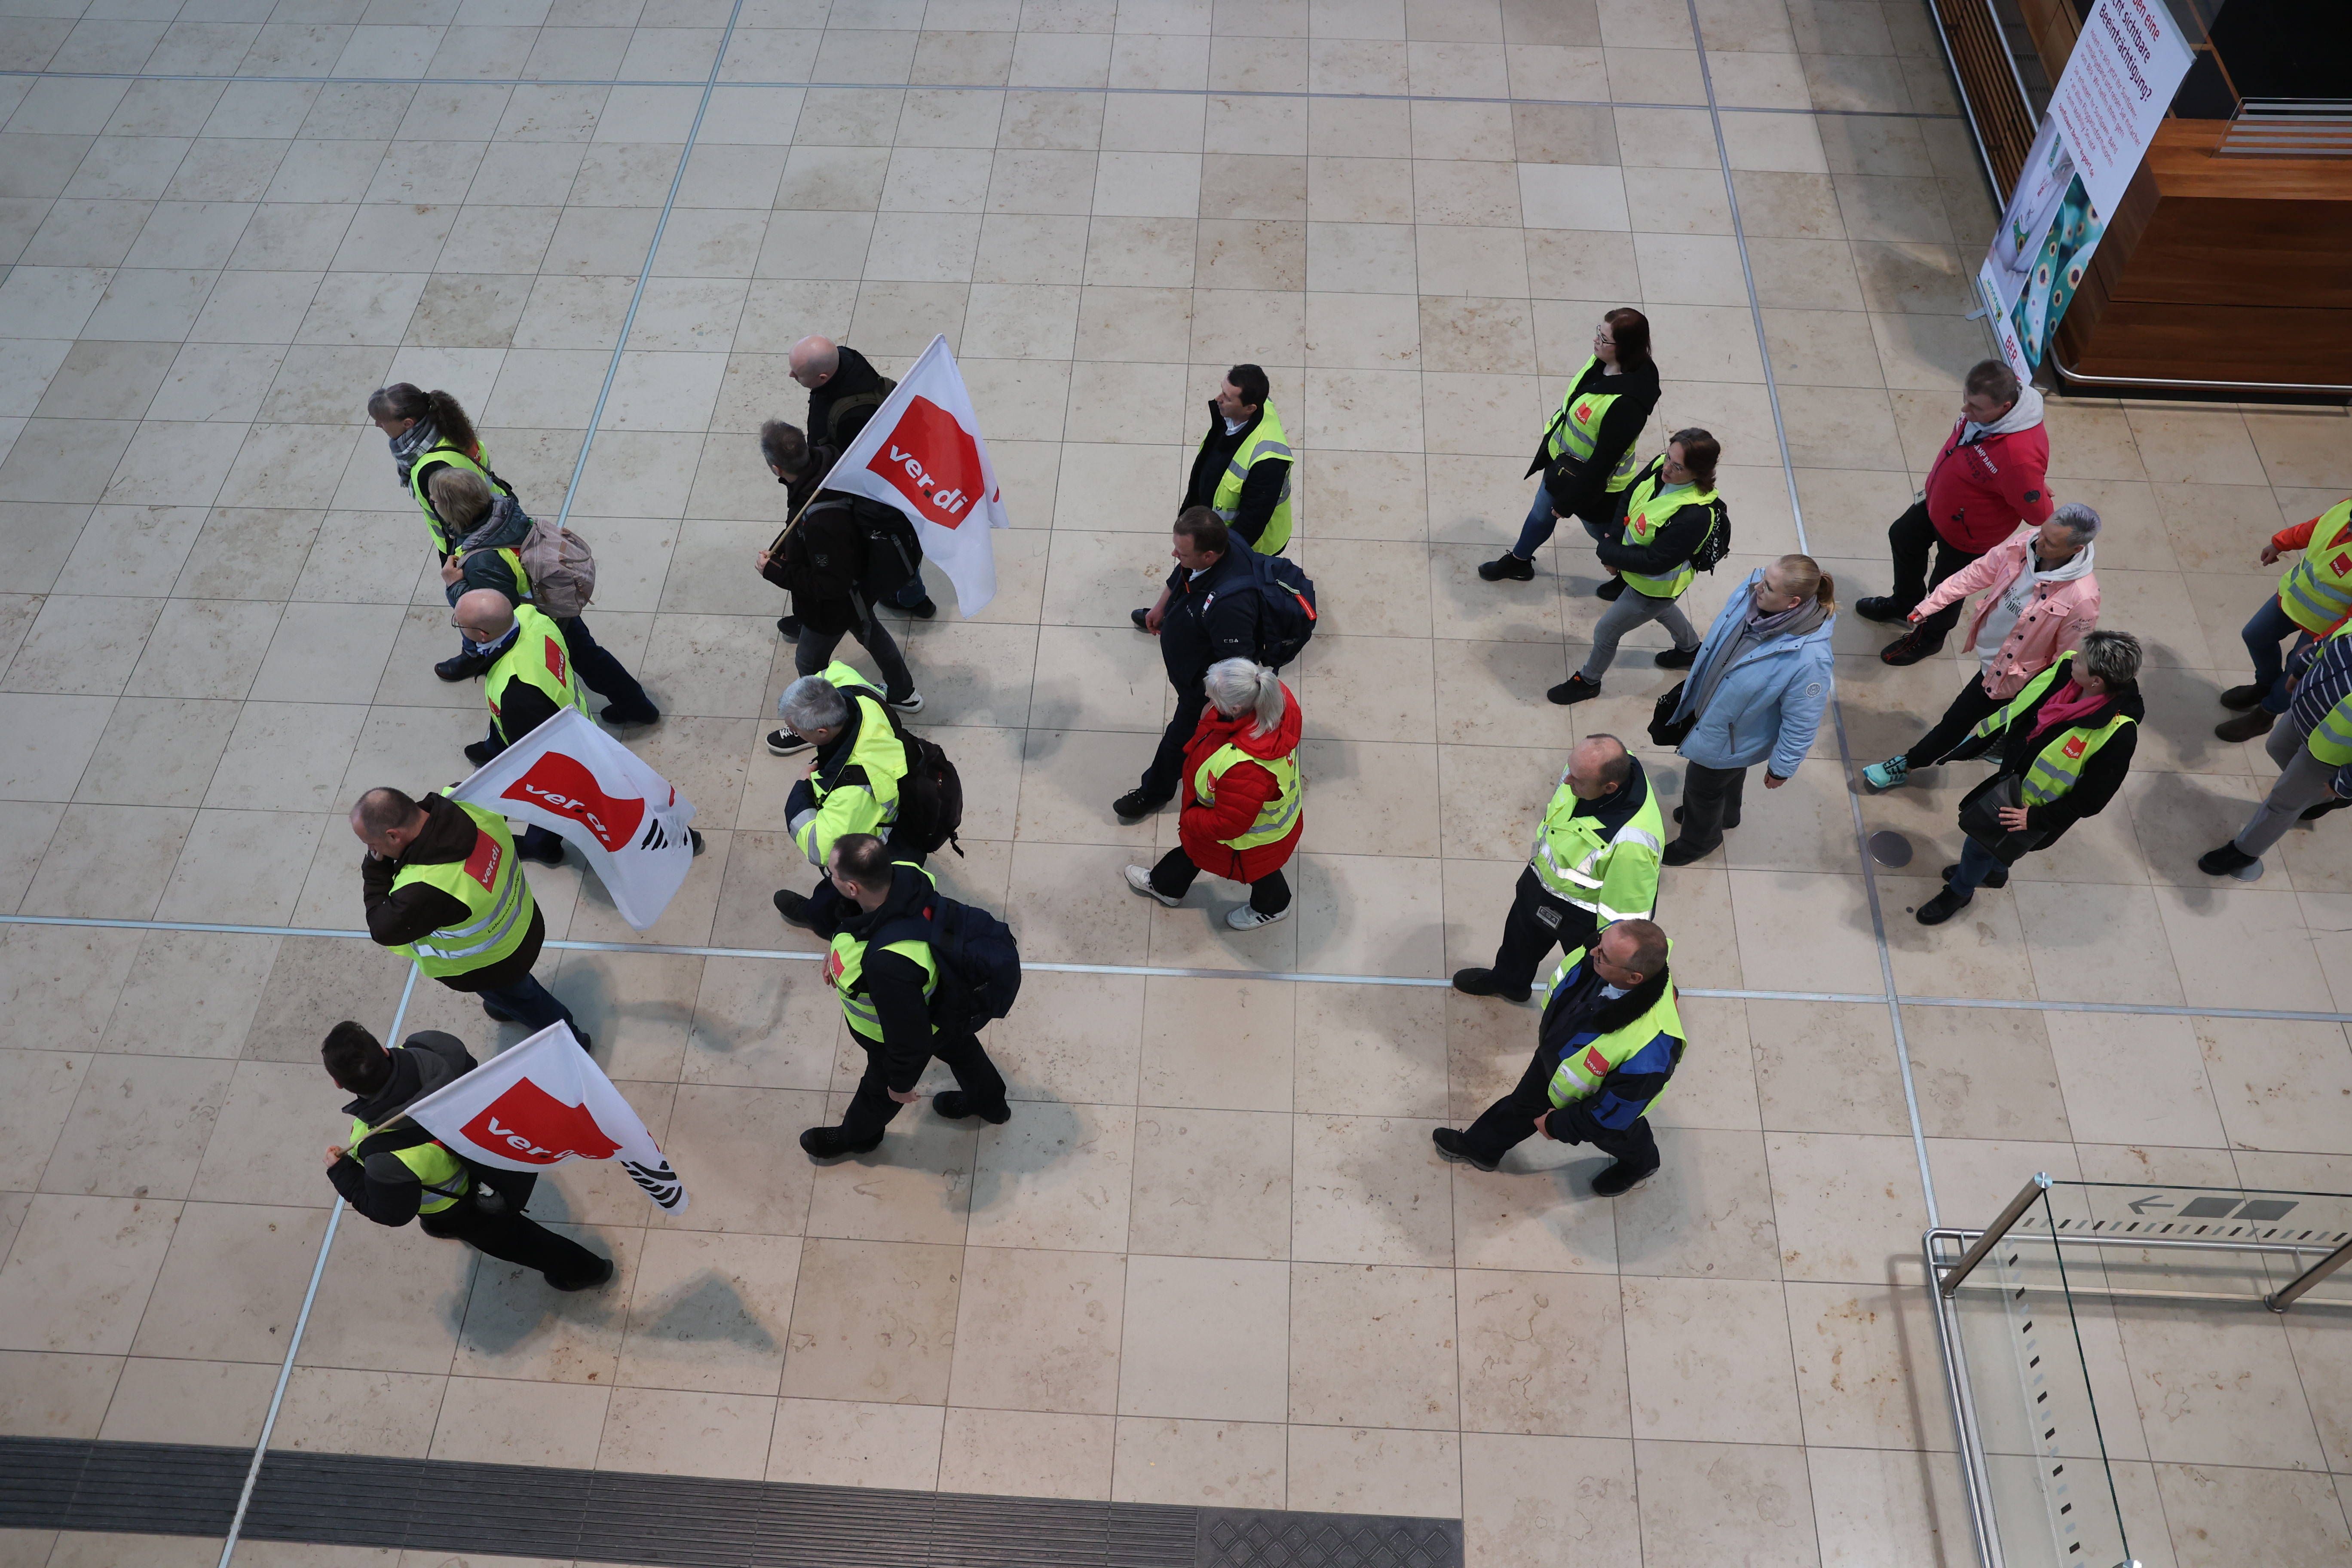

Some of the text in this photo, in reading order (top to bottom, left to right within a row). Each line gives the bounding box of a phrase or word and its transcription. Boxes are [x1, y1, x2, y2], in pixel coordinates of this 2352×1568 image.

[2122, 12, 2150, 64] sichtbare
[2144, 14, 2159, 42] eine
[2099, 3, 2152, 102] Beeinträchtigung?
[2107, 66, 2118, 82] jetzt
[2115, 122, 2124, 139] gern
[2005, 334, 2017, 364] BER
[1974, 444, 1986, 457] AMP
[1982, 456, 1998, 474] DAVID
[889, 444, 968, 514] ver.di
[2333, 560, 2345, 576] ver.di
[2066, 745, 2080, 757] ver.di
[482, 844, 500, 884] ver.di
